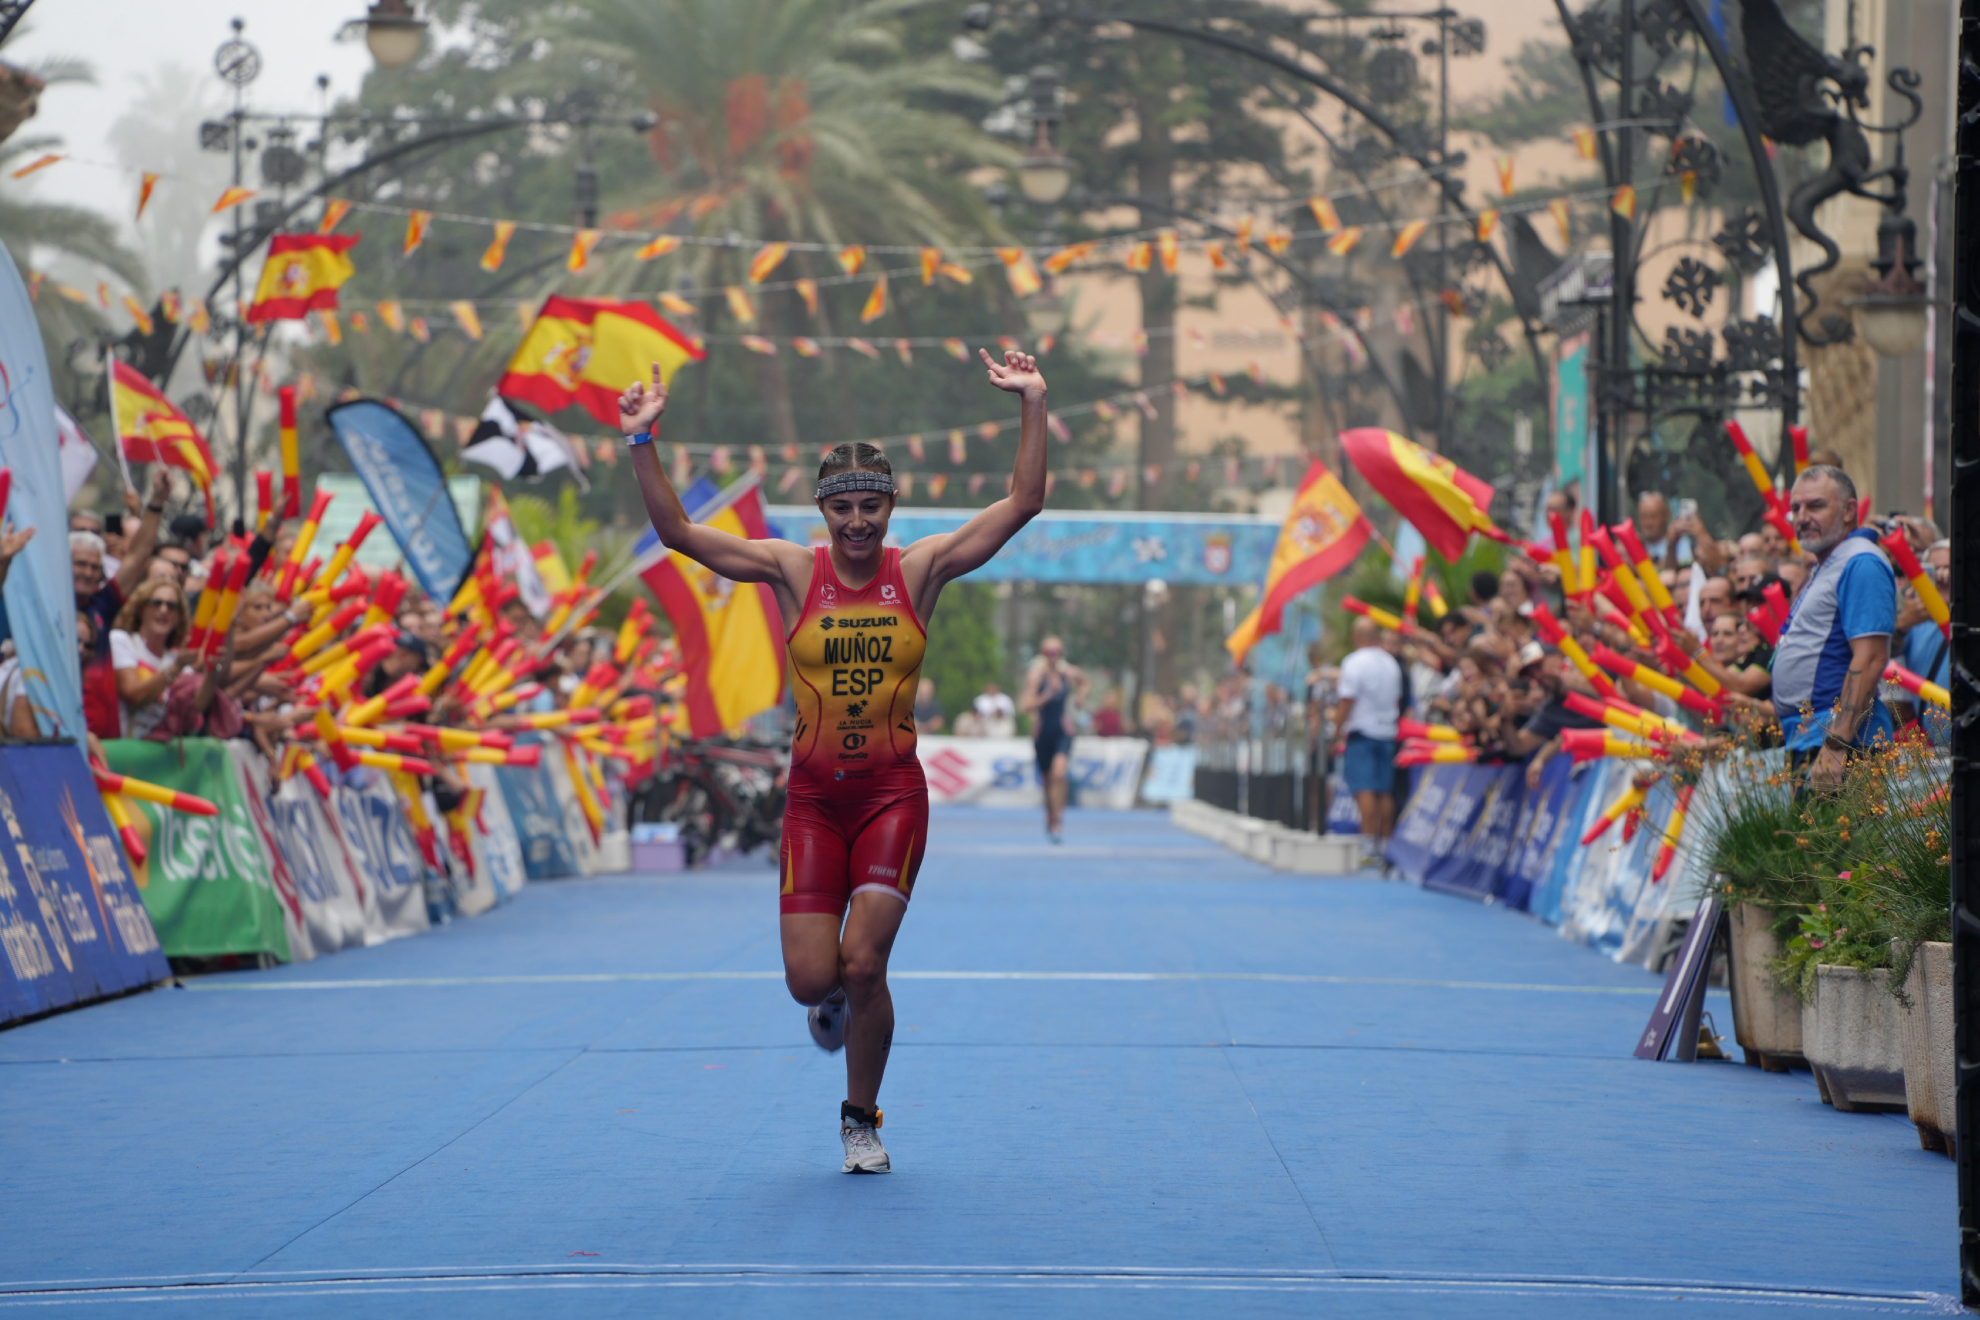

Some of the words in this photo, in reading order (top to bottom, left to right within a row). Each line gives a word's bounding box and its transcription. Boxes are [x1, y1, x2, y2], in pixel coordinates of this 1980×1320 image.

[838, 616, 898, 628] SUZUKI
[824, 632, 893, 664] MUÑOZ
[832, 668, 884, 696] ESP
